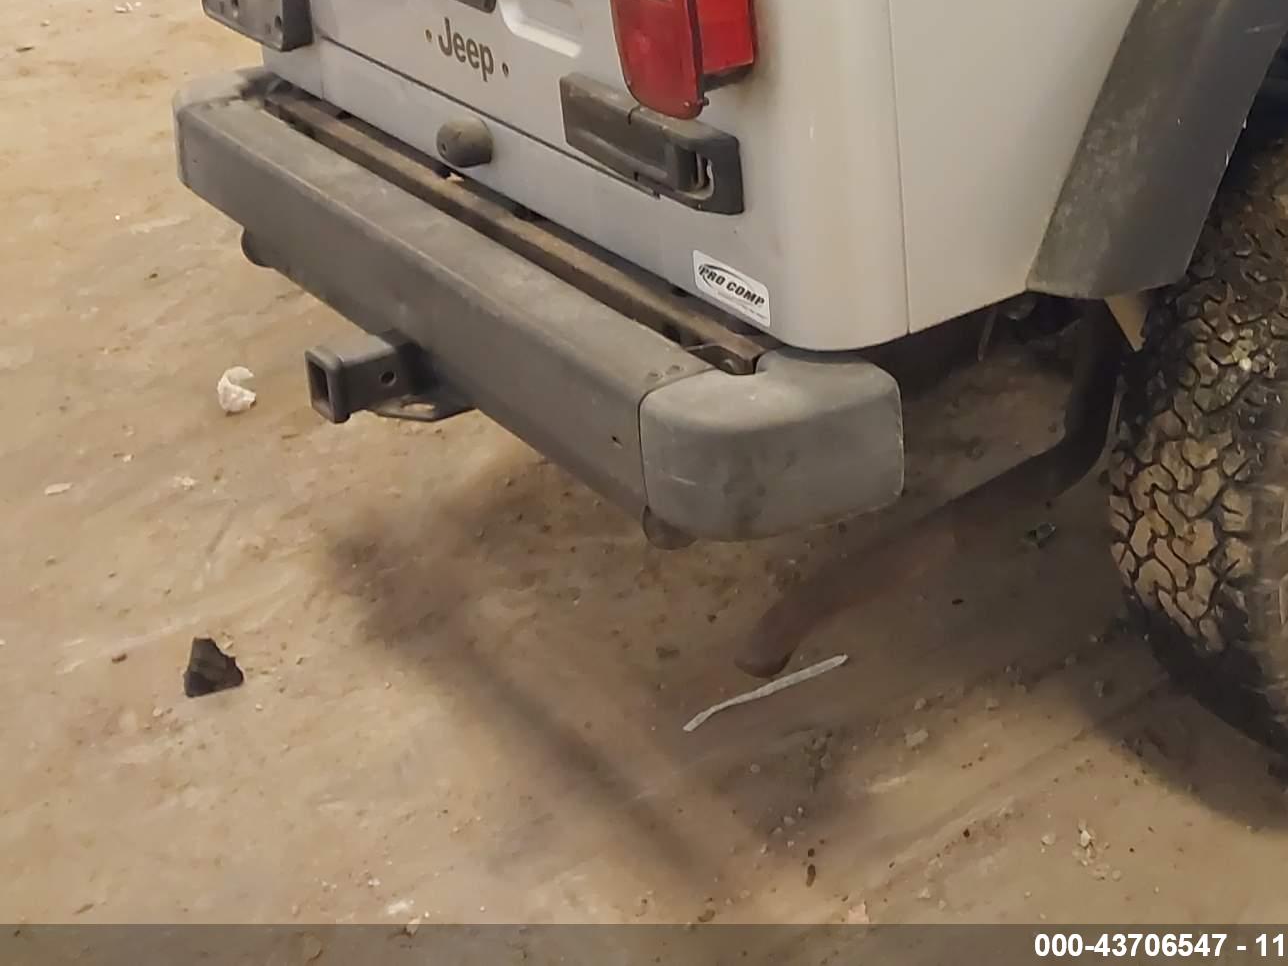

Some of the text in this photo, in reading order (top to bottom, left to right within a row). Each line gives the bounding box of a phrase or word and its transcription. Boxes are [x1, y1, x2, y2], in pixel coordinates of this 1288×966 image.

[438, 17, 494, 82] Jeep
[699, 265, 765, 305] PRO COMP
